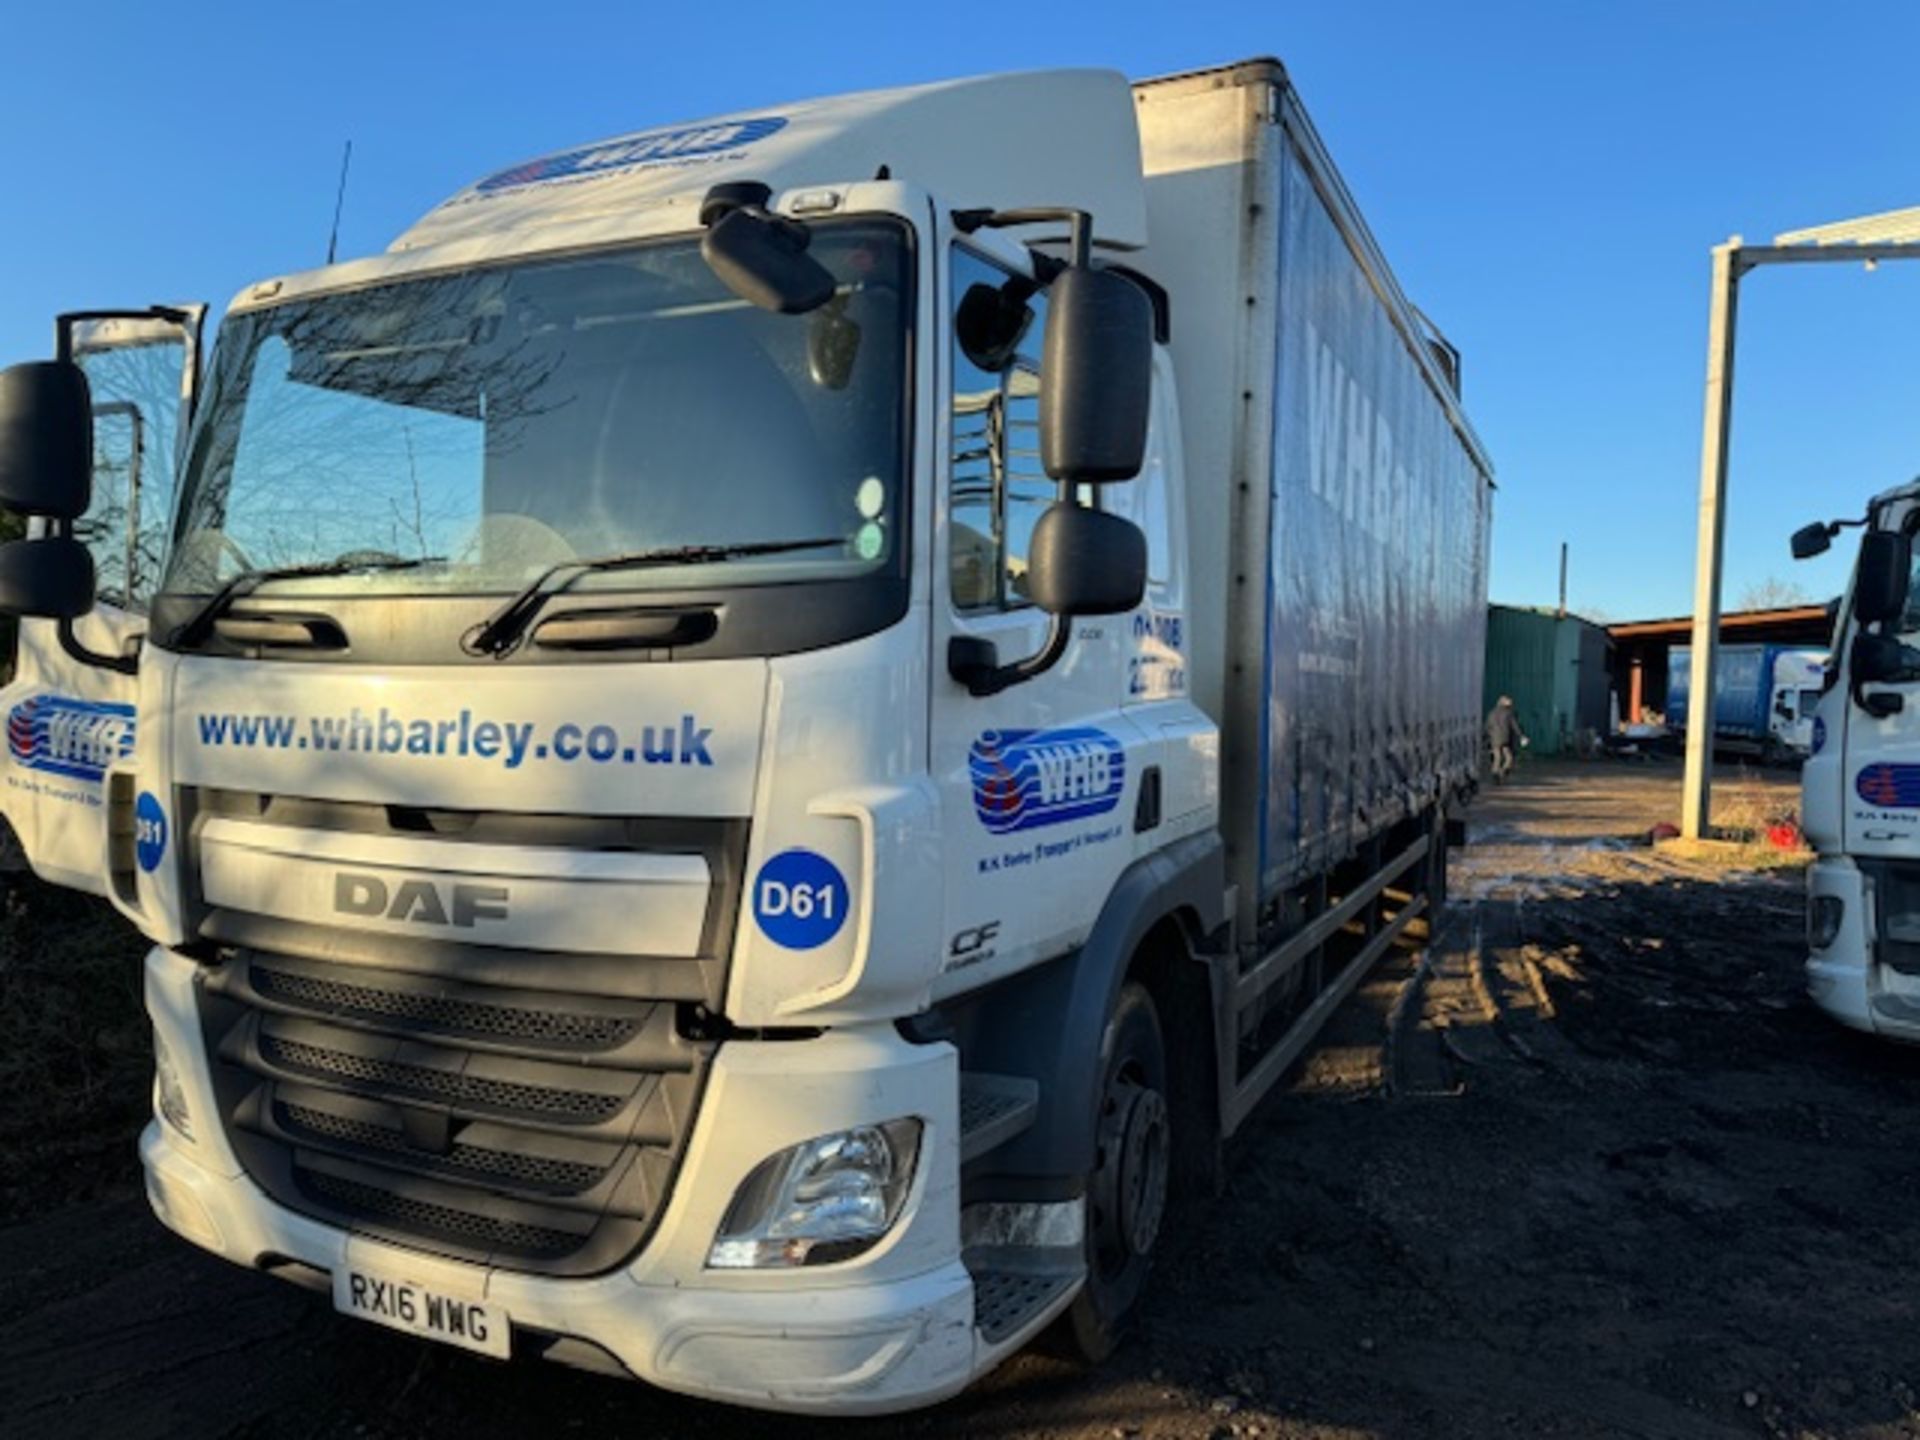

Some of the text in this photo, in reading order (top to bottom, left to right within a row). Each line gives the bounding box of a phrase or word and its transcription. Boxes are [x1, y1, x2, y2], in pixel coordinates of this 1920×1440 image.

[50, 711, 127, 769] WHB
[199, 706, 714, 769] www.whbarley.co.uk
[1028, 743, 1110, 805] WHB
[334, 872, 509, 928] DAF
[760, 880, 835, 919] D61
[949, 919, 1001, 957] CF
[350, 1273, 488, 1343] RX16 WWG
